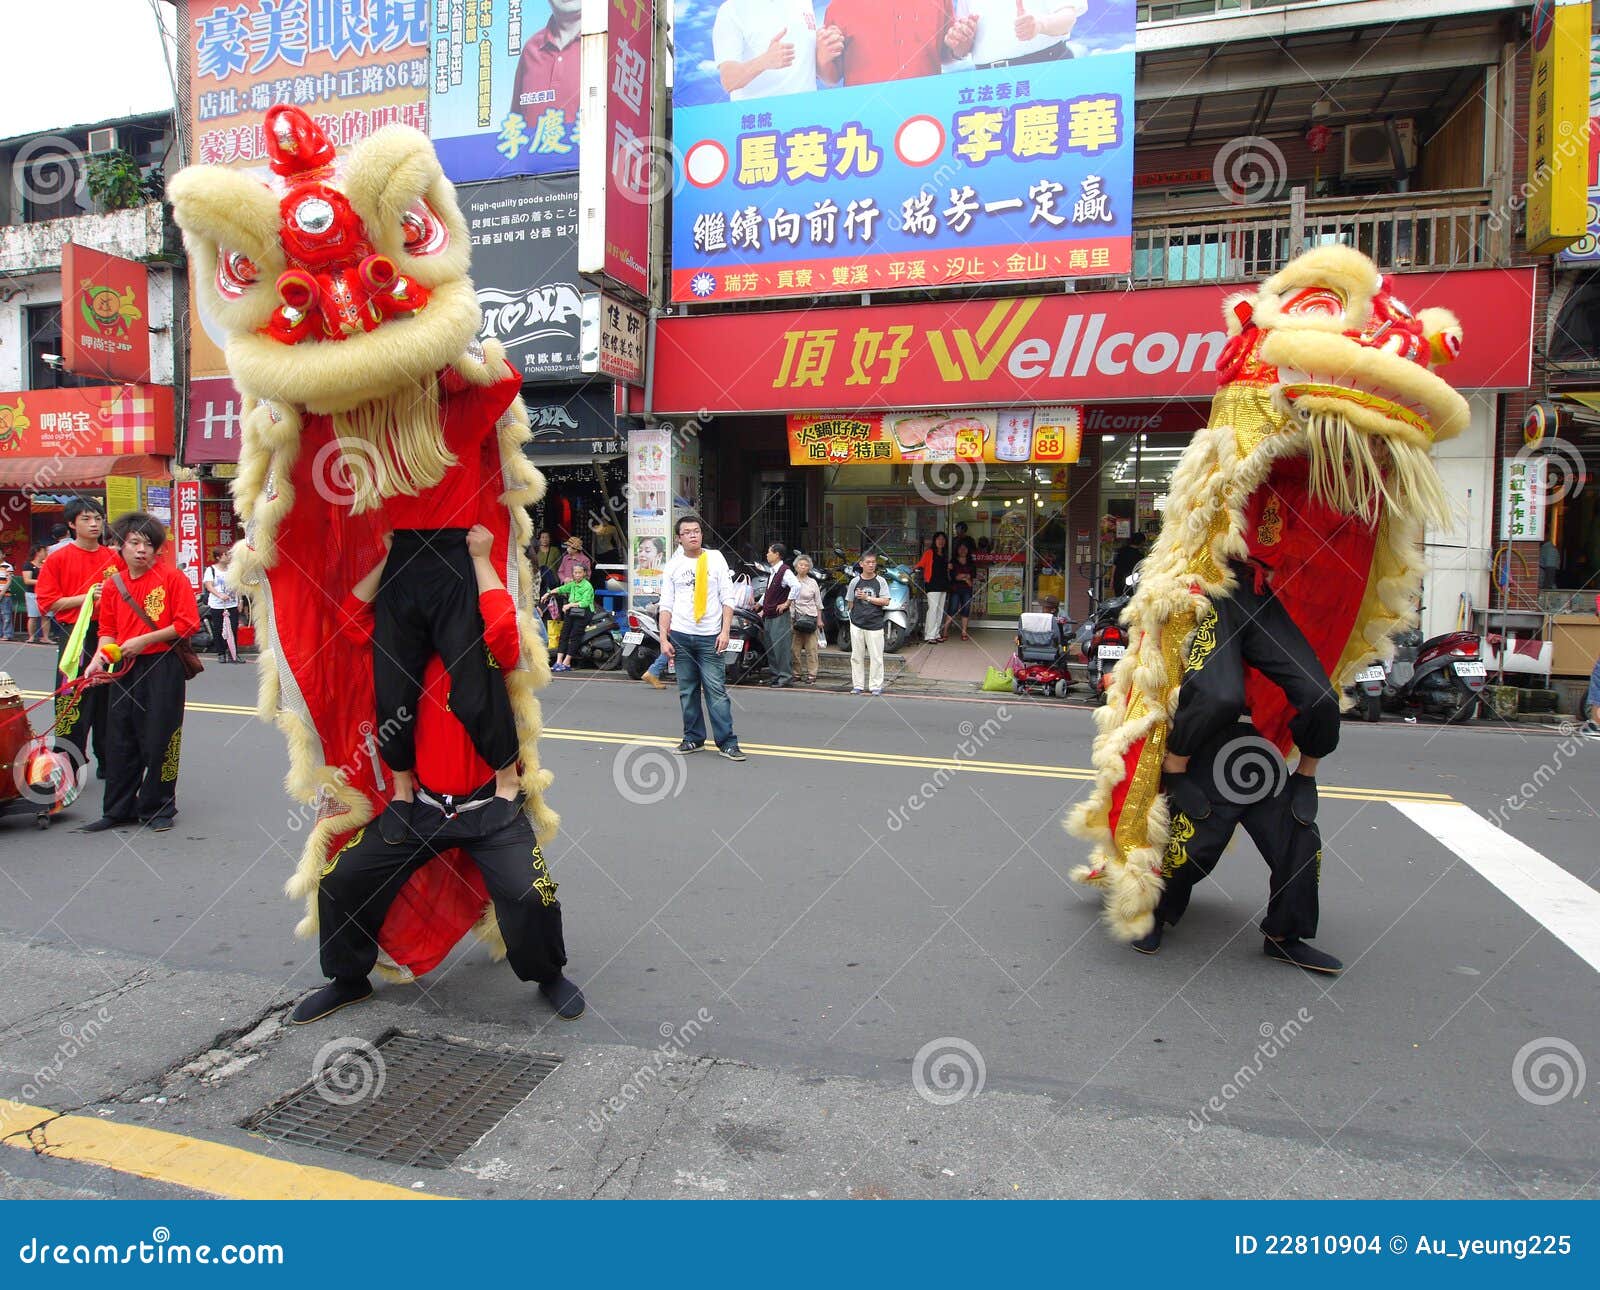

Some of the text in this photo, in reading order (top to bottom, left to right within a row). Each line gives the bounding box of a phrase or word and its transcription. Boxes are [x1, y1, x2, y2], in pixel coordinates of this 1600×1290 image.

[196, 0, 428, 80] 豪美眼鏡
[958, 81, 1031, 104] 立法委員
[741, 112, 773, 131] 總統
[957, 99, 1118, 163] 李慶華
[497, 108, 580, 160] 李慶
[738, 126, 879, 186] 馬英九
[471, 191, 578, 212] High-quality goods clothing
[772, 296, 1226, 388] 頂好 Wellcom
[40, 411, 90, 432] 呷尚宝
[796, 420, 871, 445] 火鍋好料
[809, 439, 892, 459] 哈燒特賣
[958, 442, 979, 456] 59
[1038, 440, 1059, 453] 88
